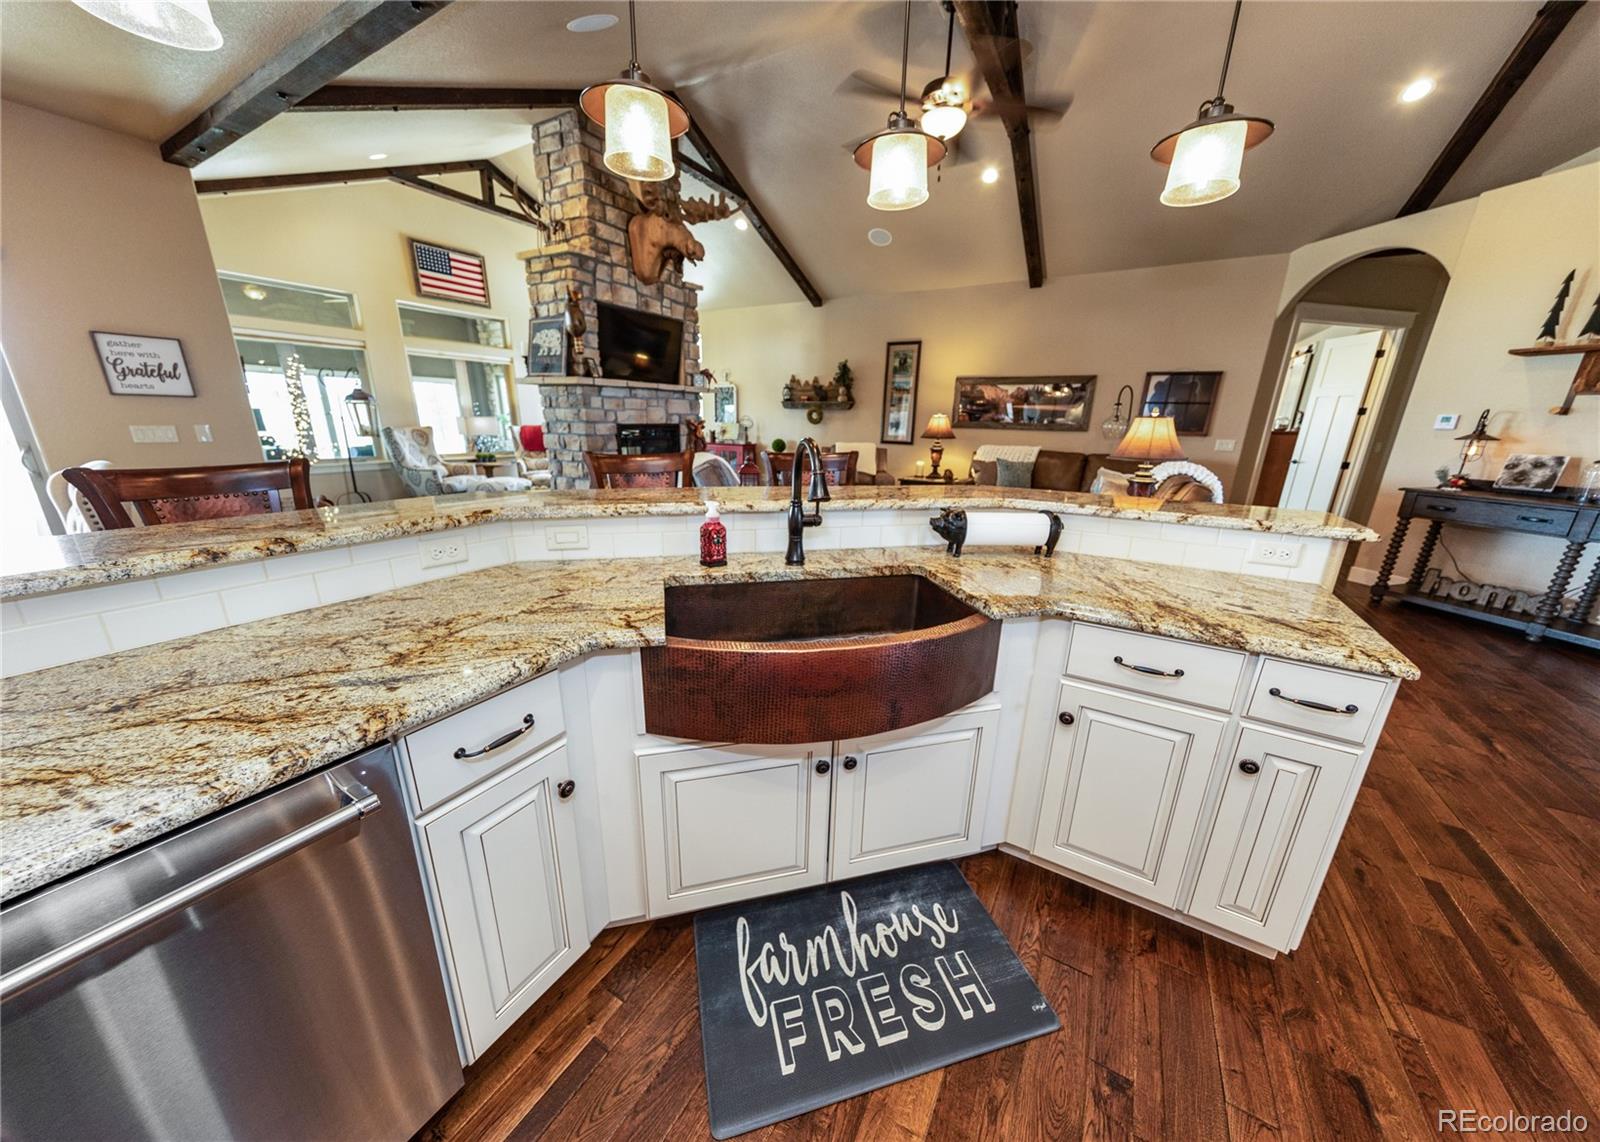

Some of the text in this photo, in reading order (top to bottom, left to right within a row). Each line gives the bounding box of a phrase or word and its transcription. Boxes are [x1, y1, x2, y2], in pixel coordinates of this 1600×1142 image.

[106, 340, 142, 349] gather
[110, 350, 161, 359] here with
[105, 356, 181, 383] Grateful
[120, 382, 156, 390] hearts
[736, 890, 959, 1027] farmhouse
[769, 950, 996, 1076] FRESH
